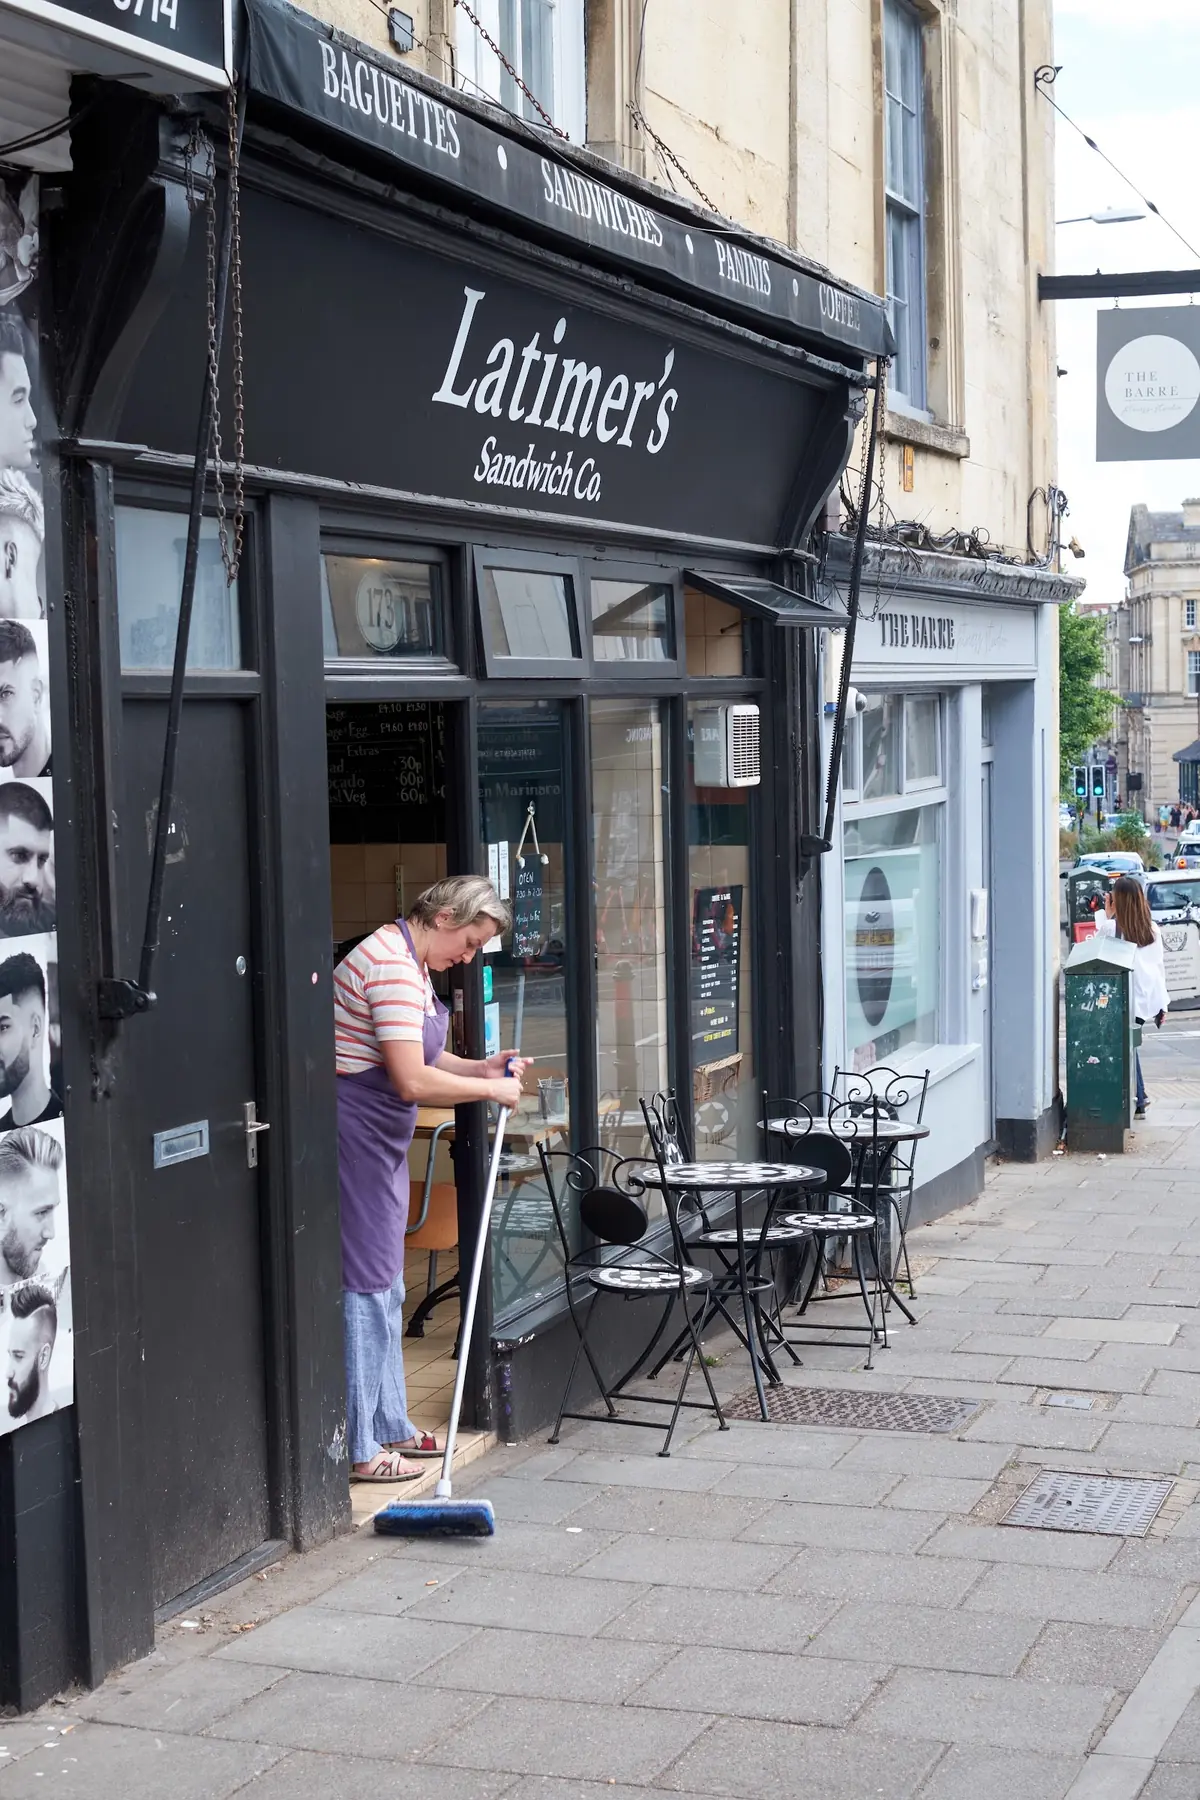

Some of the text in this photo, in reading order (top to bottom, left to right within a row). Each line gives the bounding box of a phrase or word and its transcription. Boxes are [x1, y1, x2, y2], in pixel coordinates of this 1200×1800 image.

[318, 39, 861, 331] BAGUETTES SANDWICHES PANINIS COFFEE
[432, 285, 679, 454] Latimer's
[1124, 371, 1158, 382] THE
[1125, 385, 1179, 398] BARRE
[473, 435, 602, 502] Sandwich Co.
[366, 587, 395, 629] 173
[878, 612, 910, 648] THE
[911, 614, 955, 650] BARRE
[346, 743, 380, 757] Extras
[398, 756, 423, 774] 30p
[399, 771, 425, 789] 60p
[342, 788, 368, 807] Veg
[400, 787, 426, 805] 60p
[495, 781, 561, 799] Marinara
[518, 872, 534, 885] OPEN
